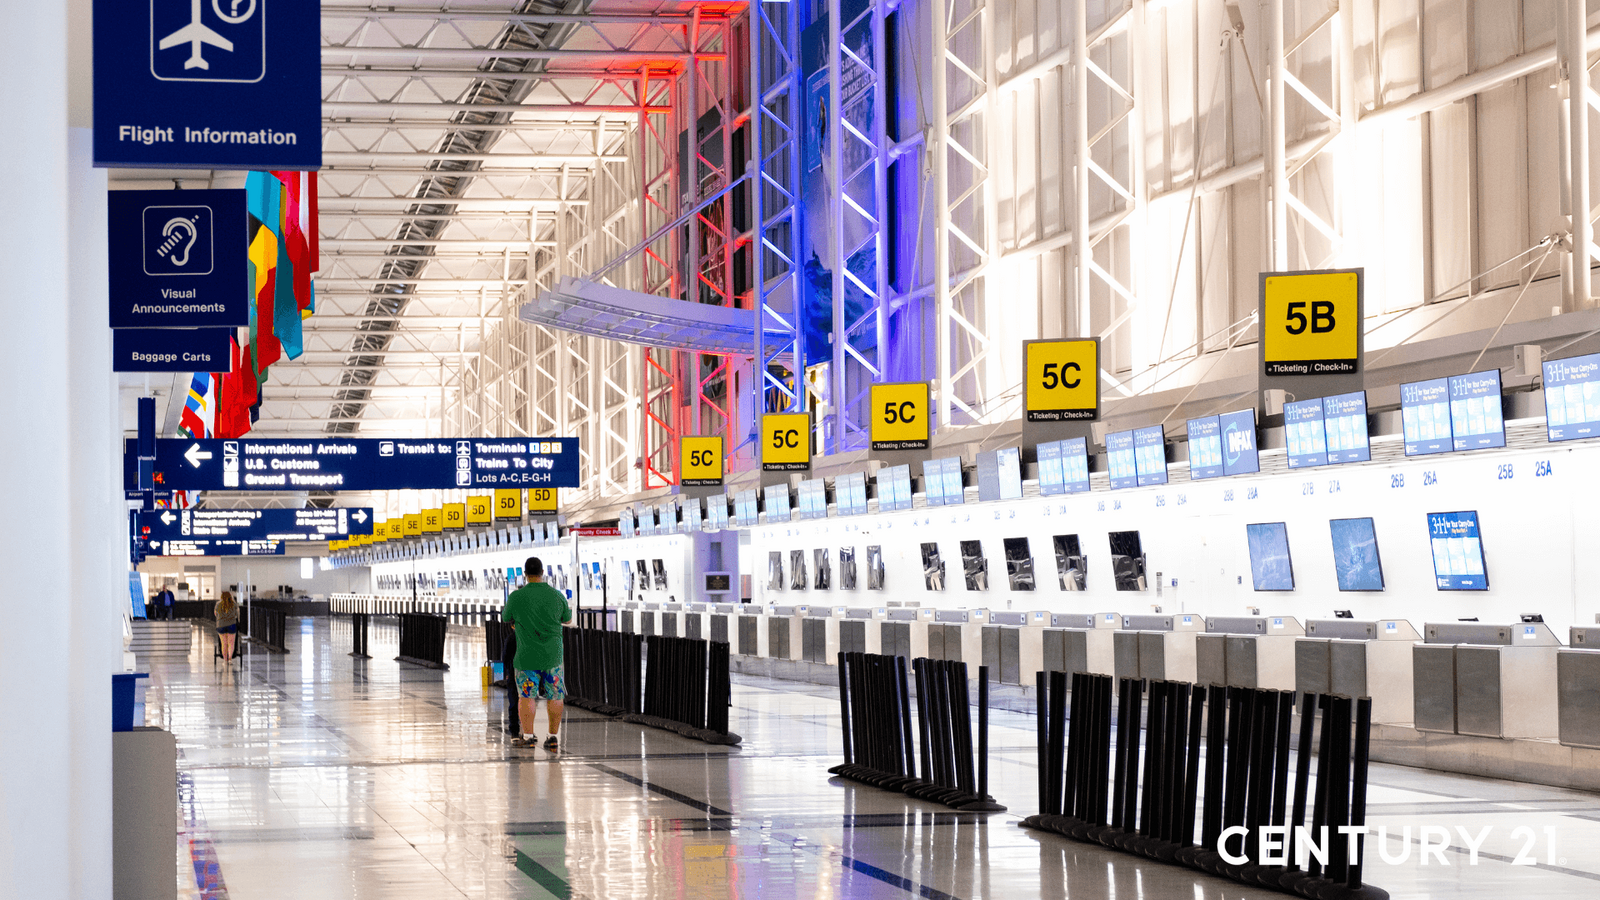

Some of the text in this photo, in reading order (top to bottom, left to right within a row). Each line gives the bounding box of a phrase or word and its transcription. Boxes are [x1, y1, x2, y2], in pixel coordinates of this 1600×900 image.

[119, 125, 297, 145] Flight Information
[161, 289, 196, 299] Visual
[132, 303, 225, 314] Announcements
[1285, 301, 1336, 335] 5B
[132, 352, 211, 362] Baggage Carts
[1273, 364, 1308, 373] Ticketing
[1314, 363, 1349, 372] Check-In
[1548, 363, 1566, 383] 3-1-1
[1042, 362, 1081, 389] 5C
[1453, 378, 1468, 396] 3-1-1
[1404, 385, 1419, 403] 3-1-1
[1326, 398, 1339, 414] 3-1-1
[884, 401, 915, 424] 5C
[1033, 412, 1060, 421] Ticketing
[1064, 411, 1090, 419] Check-In
[1287, 404, 1299, 421] 3-1-1
[773, 429, 799, 448] 5C
[1228, 430, 1252, 453] INFAX
[245, 444, 357, 454] International Arrivals
[397, 443, 452, 454] Transit to:
[476, 443, 526, 453] Terminals
[690, 449, 713, 466] 5C
[245, 459, 319, 469] U.S. Customs
[476, 458, 554, 469] Trains To City
[1498, 460, 1552, 480] 25B 25A
[245, 473, 343, 486] Ground Transport
[476, 473, 551, 484] Lots A-C,E-G-H
[1391, 471, 1437, 488] 26B 26A
[1302, 480, 1341, 495] 27B 27A
[535, 489, 550, 501] 5D
[501, 498, 515, 509] 5D
[472, 505, 485, 515] 5D
[426, 516, 437, 525] 5E
[447, 511, 460, 521] 5D
[391, 525, 400, 533] 5E
[407, 521, 418, 529] 5E
[1432, 517, 1448, 534] 3-1-1
[376, 528, 385, 536] 5E
